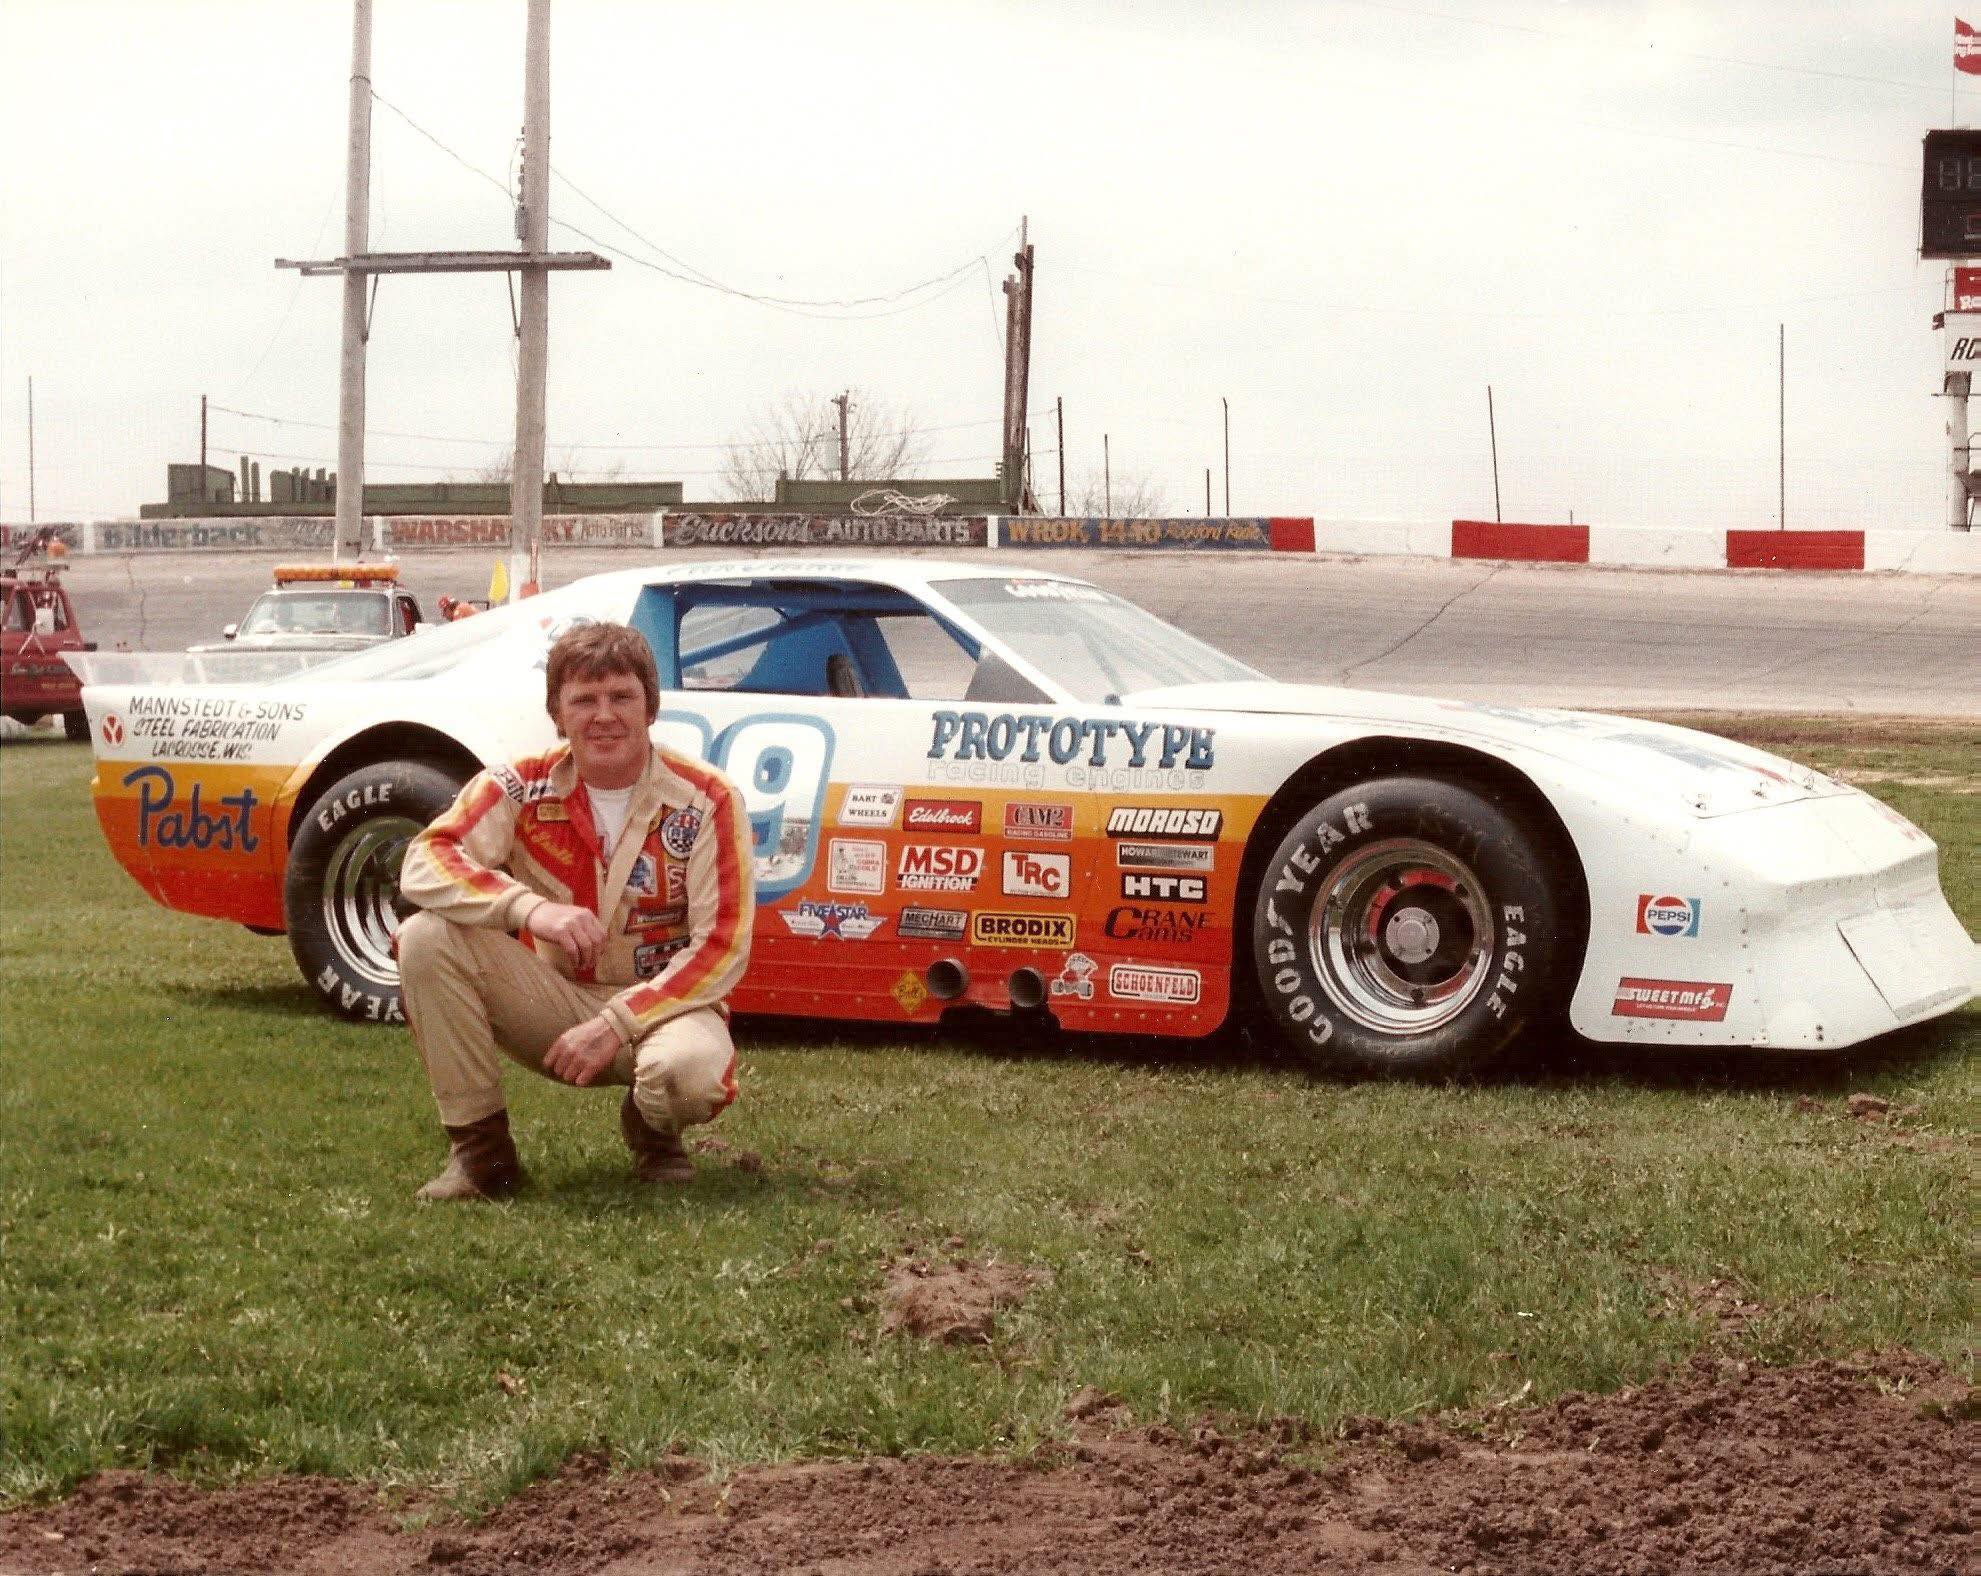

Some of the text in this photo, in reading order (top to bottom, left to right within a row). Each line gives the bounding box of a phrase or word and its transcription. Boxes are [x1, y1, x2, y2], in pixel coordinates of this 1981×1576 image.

[391, 519, 579, 543] WARSHAKY
[826, 520, 890, 542] AUTO
[898, 520, 970, 543] PARTS
[129, 695, 237, 717] MANNSTEDT
[256, 702, 308, 721] SONS
[133, 718, 283, 741] STEEL FABRICATION
[926, 710, 1217, 770] PROTOTYPE
[926, 759, 1207, 792] racing engines
[122, 765, 260, 853] Pabst
[317, 783, 394, 832] EAGLE
[849, 808, 888, 819] WHEELS
[907, 806, 974, 825] Edelbrock
[1108, 807, 1220, 835] MOROSO
[903, 846, 979, 876] MSD
[1011, 853, 1061, 892] TRC
[901, 875, 973, 891] IGNITION
[1124, 875, 1204, 899] HTC
[799, 903, 867, 920] FIVE STAR
[1647, 909, 1691, 923] PEPSI
[981, 917, 1067, 938] BRODIX
[987, 937, 1028, 945] CYLINDER
[1486, 904, 1527, 1020] EAGLE
[317, 964, 406, 1023] YEAR
[1116, 972, 1195, 996] SCHOENFELD
